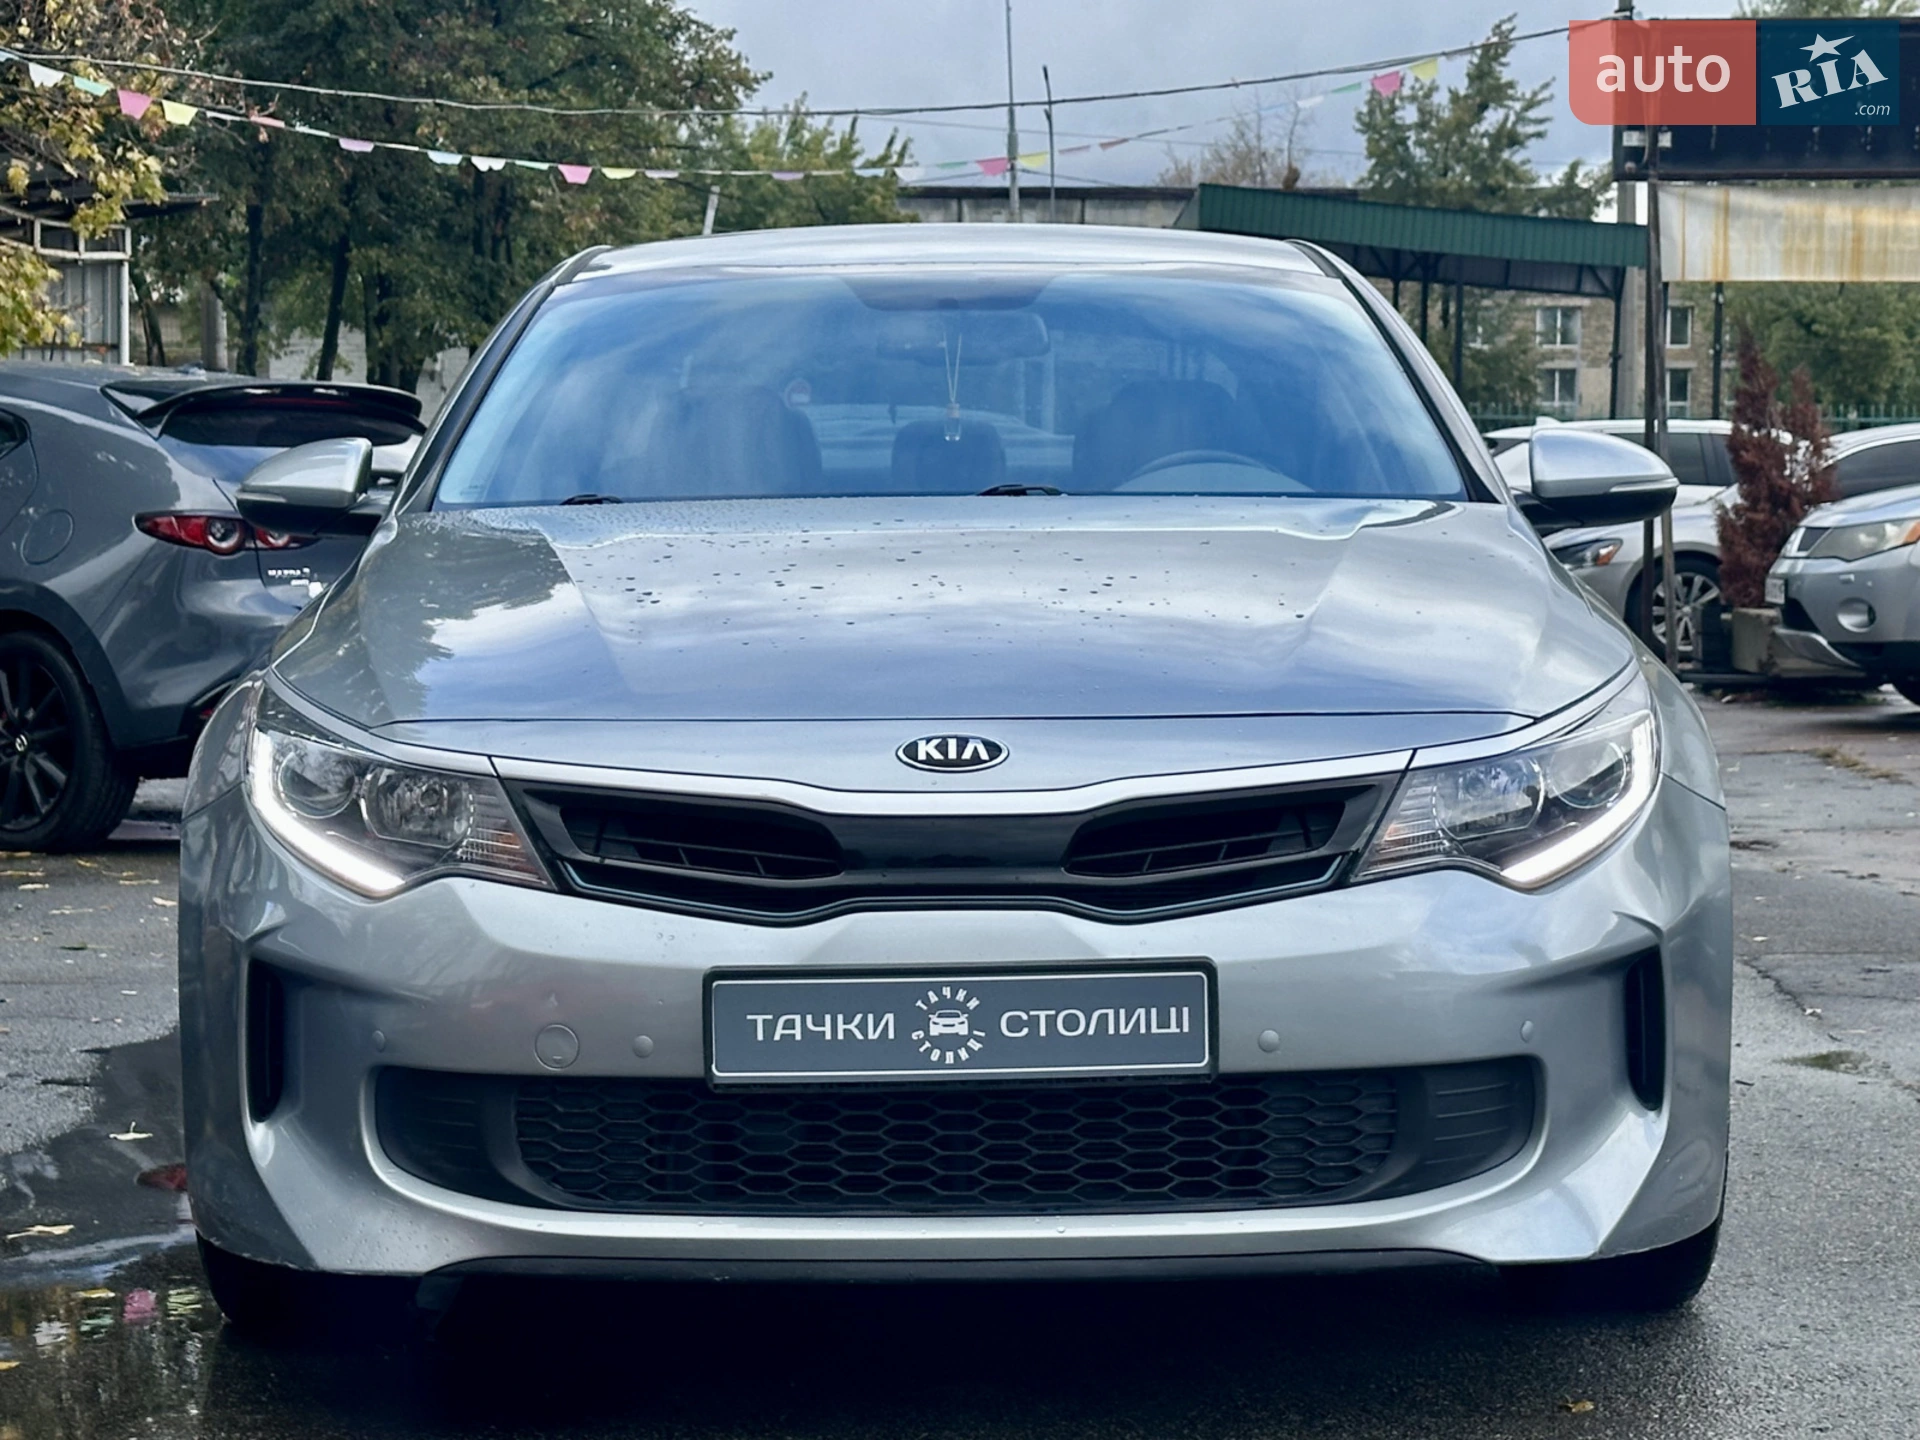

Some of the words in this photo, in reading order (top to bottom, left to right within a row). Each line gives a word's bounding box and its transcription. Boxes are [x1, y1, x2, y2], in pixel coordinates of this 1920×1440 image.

[916, 737, 990, 761] KIA
[914, 986, 981, 1011] ТАЧКИ
[746, 1013, 896, 1042] ТАЧКИ
[999, 1006, 1191, 1038] СТОЛИЦІ
